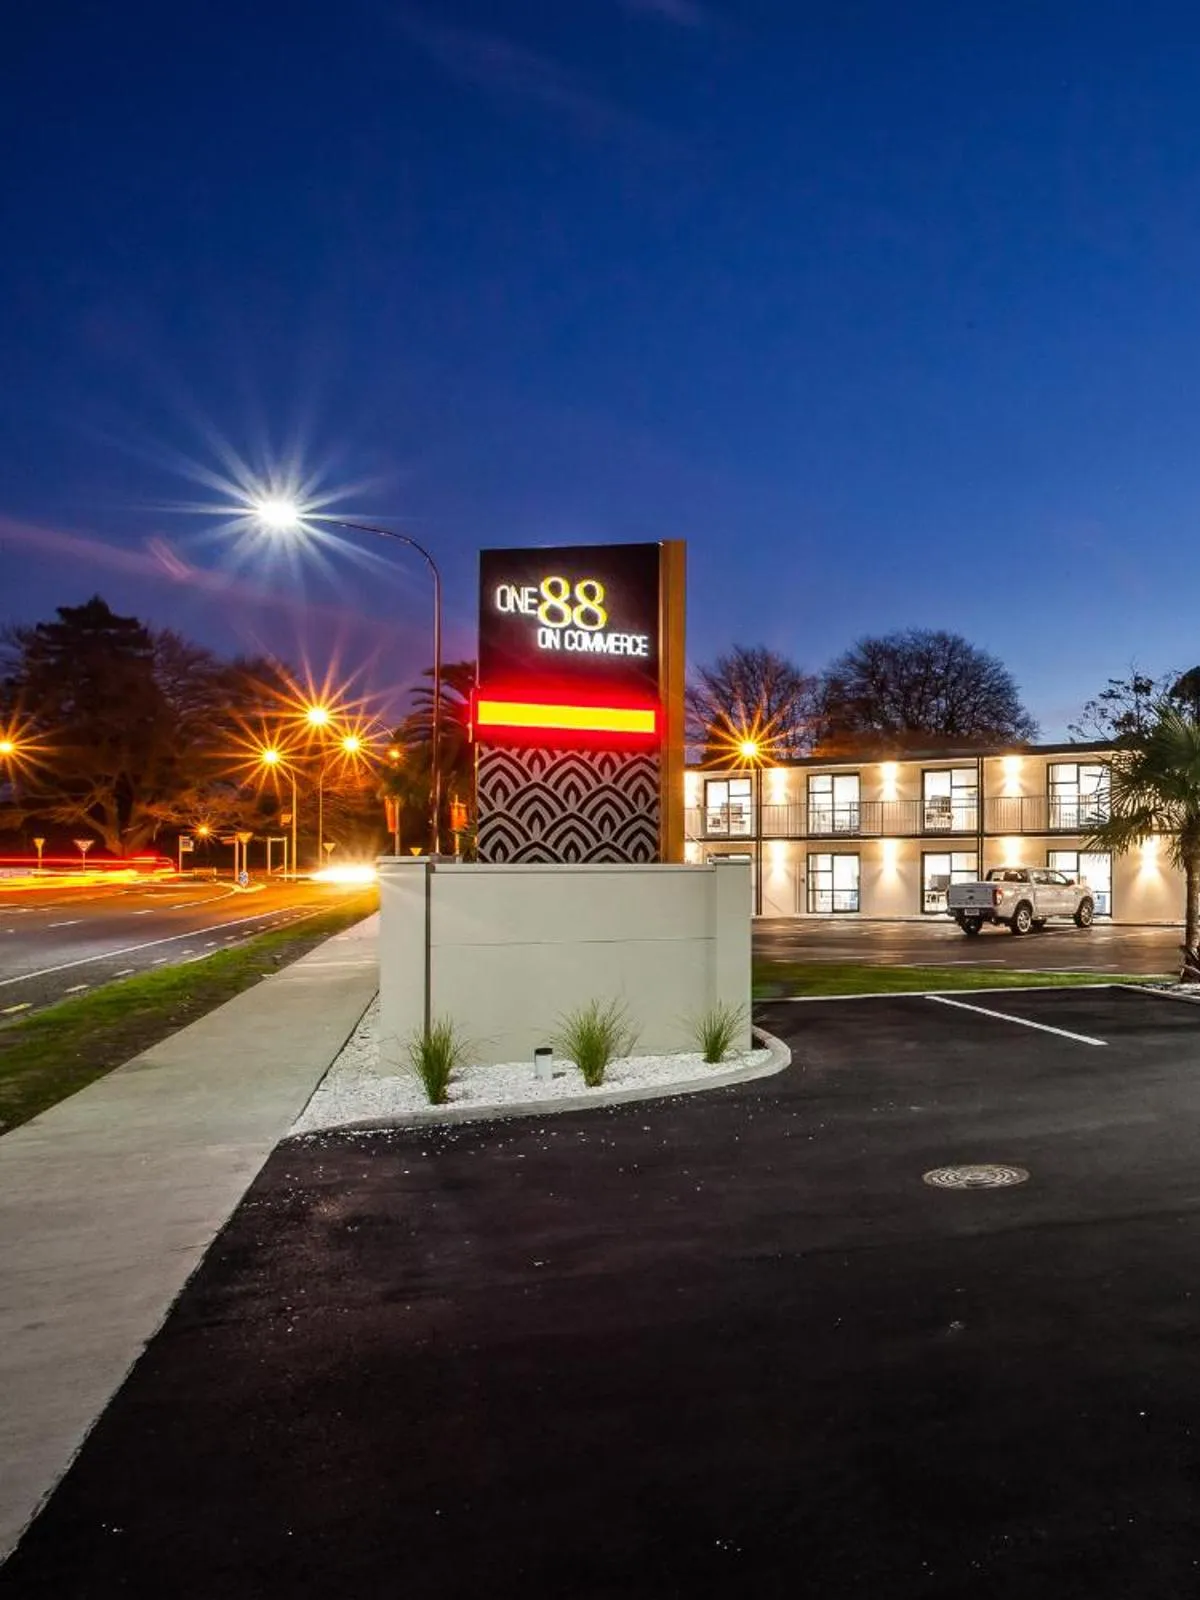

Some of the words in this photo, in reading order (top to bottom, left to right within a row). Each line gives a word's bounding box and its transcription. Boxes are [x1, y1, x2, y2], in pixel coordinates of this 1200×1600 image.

[496, 584, 538, 615] ONE
[537, 576, 608, 631] 88
[537, 627, 561, 650] ON
[564, 629, 648, 657] COMMERCE
